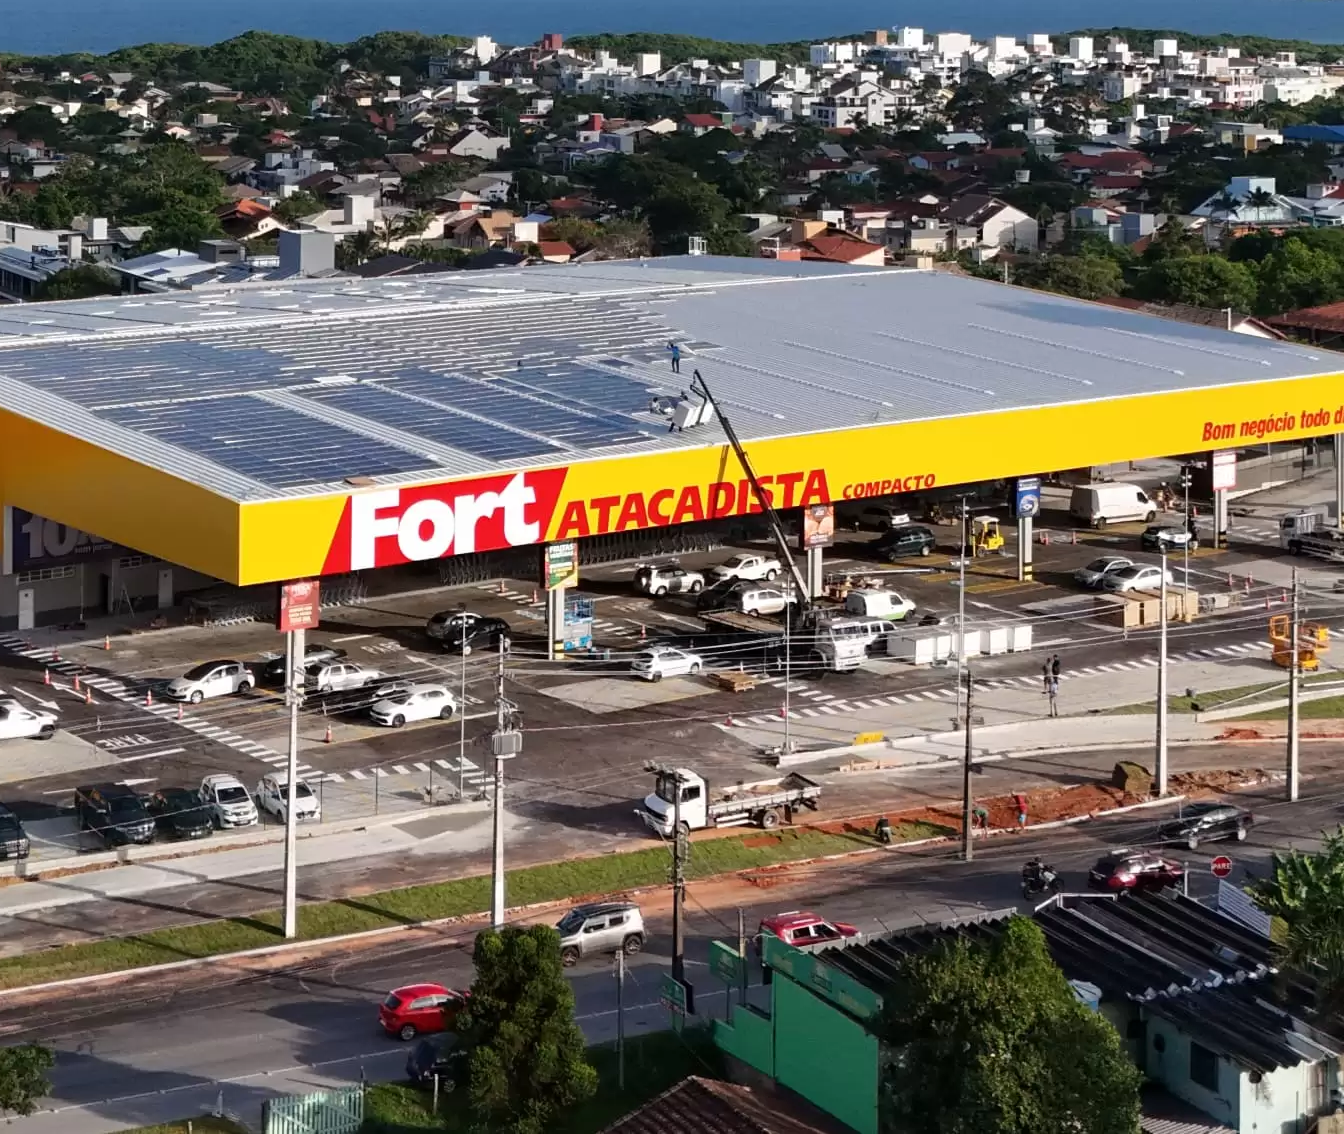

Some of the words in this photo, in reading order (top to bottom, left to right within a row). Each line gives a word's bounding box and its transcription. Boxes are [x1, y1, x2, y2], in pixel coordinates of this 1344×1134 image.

[1202, 422, 1235, 441] Bom
[1240, 412, 1295, 438] negócio
[1300, 408, 1330, 428] todo
[351, 472, 540, 571] Fort
[556, 468, 830, 538] ATACADISTA
[843, 473, 936, 500] COMPACTO
[96, 733, 154, 751] PARE
